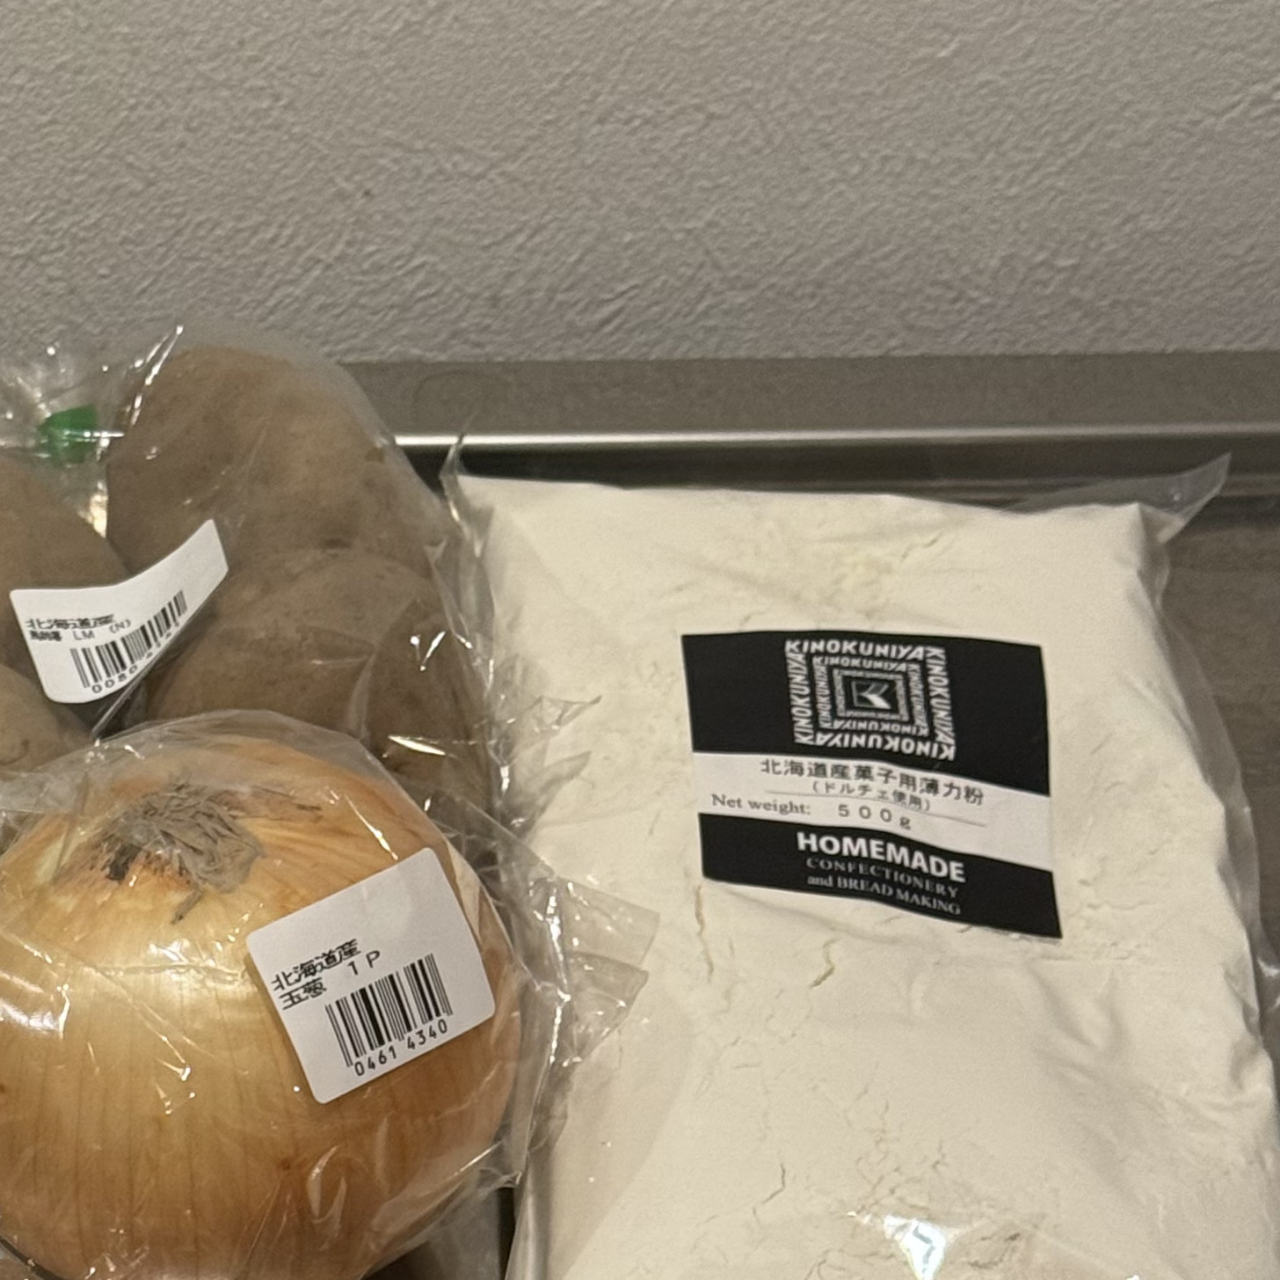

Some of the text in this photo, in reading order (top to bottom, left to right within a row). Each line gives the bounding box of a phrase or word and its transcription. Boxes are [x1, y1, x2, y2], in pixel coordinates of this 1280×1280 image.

[785, 639, 926, 661] KINOKUNIYA
[812, 656, 908, 672] KINOKUNIYA
[785, 652, 815, 746] KINOKUNIYA
[925, 646, 956, 746] KINOKUNIYA
[814, 731, 957, 762] KINOKUNIYA
[761, 758, 984, 807] 北海道産菓子用薄力粉
[711, 793, 912, 831] Net weight: 500g
[796, 831, 966, 883] HOMEMADE
[806, 857, 959, 898] CONFECTIONERY
[807, 875, 961, 915] and BREAD MAKING
[271, 938, 362, 992] 北海道産
[353, 1018, 449, 1077] 0461 4340
